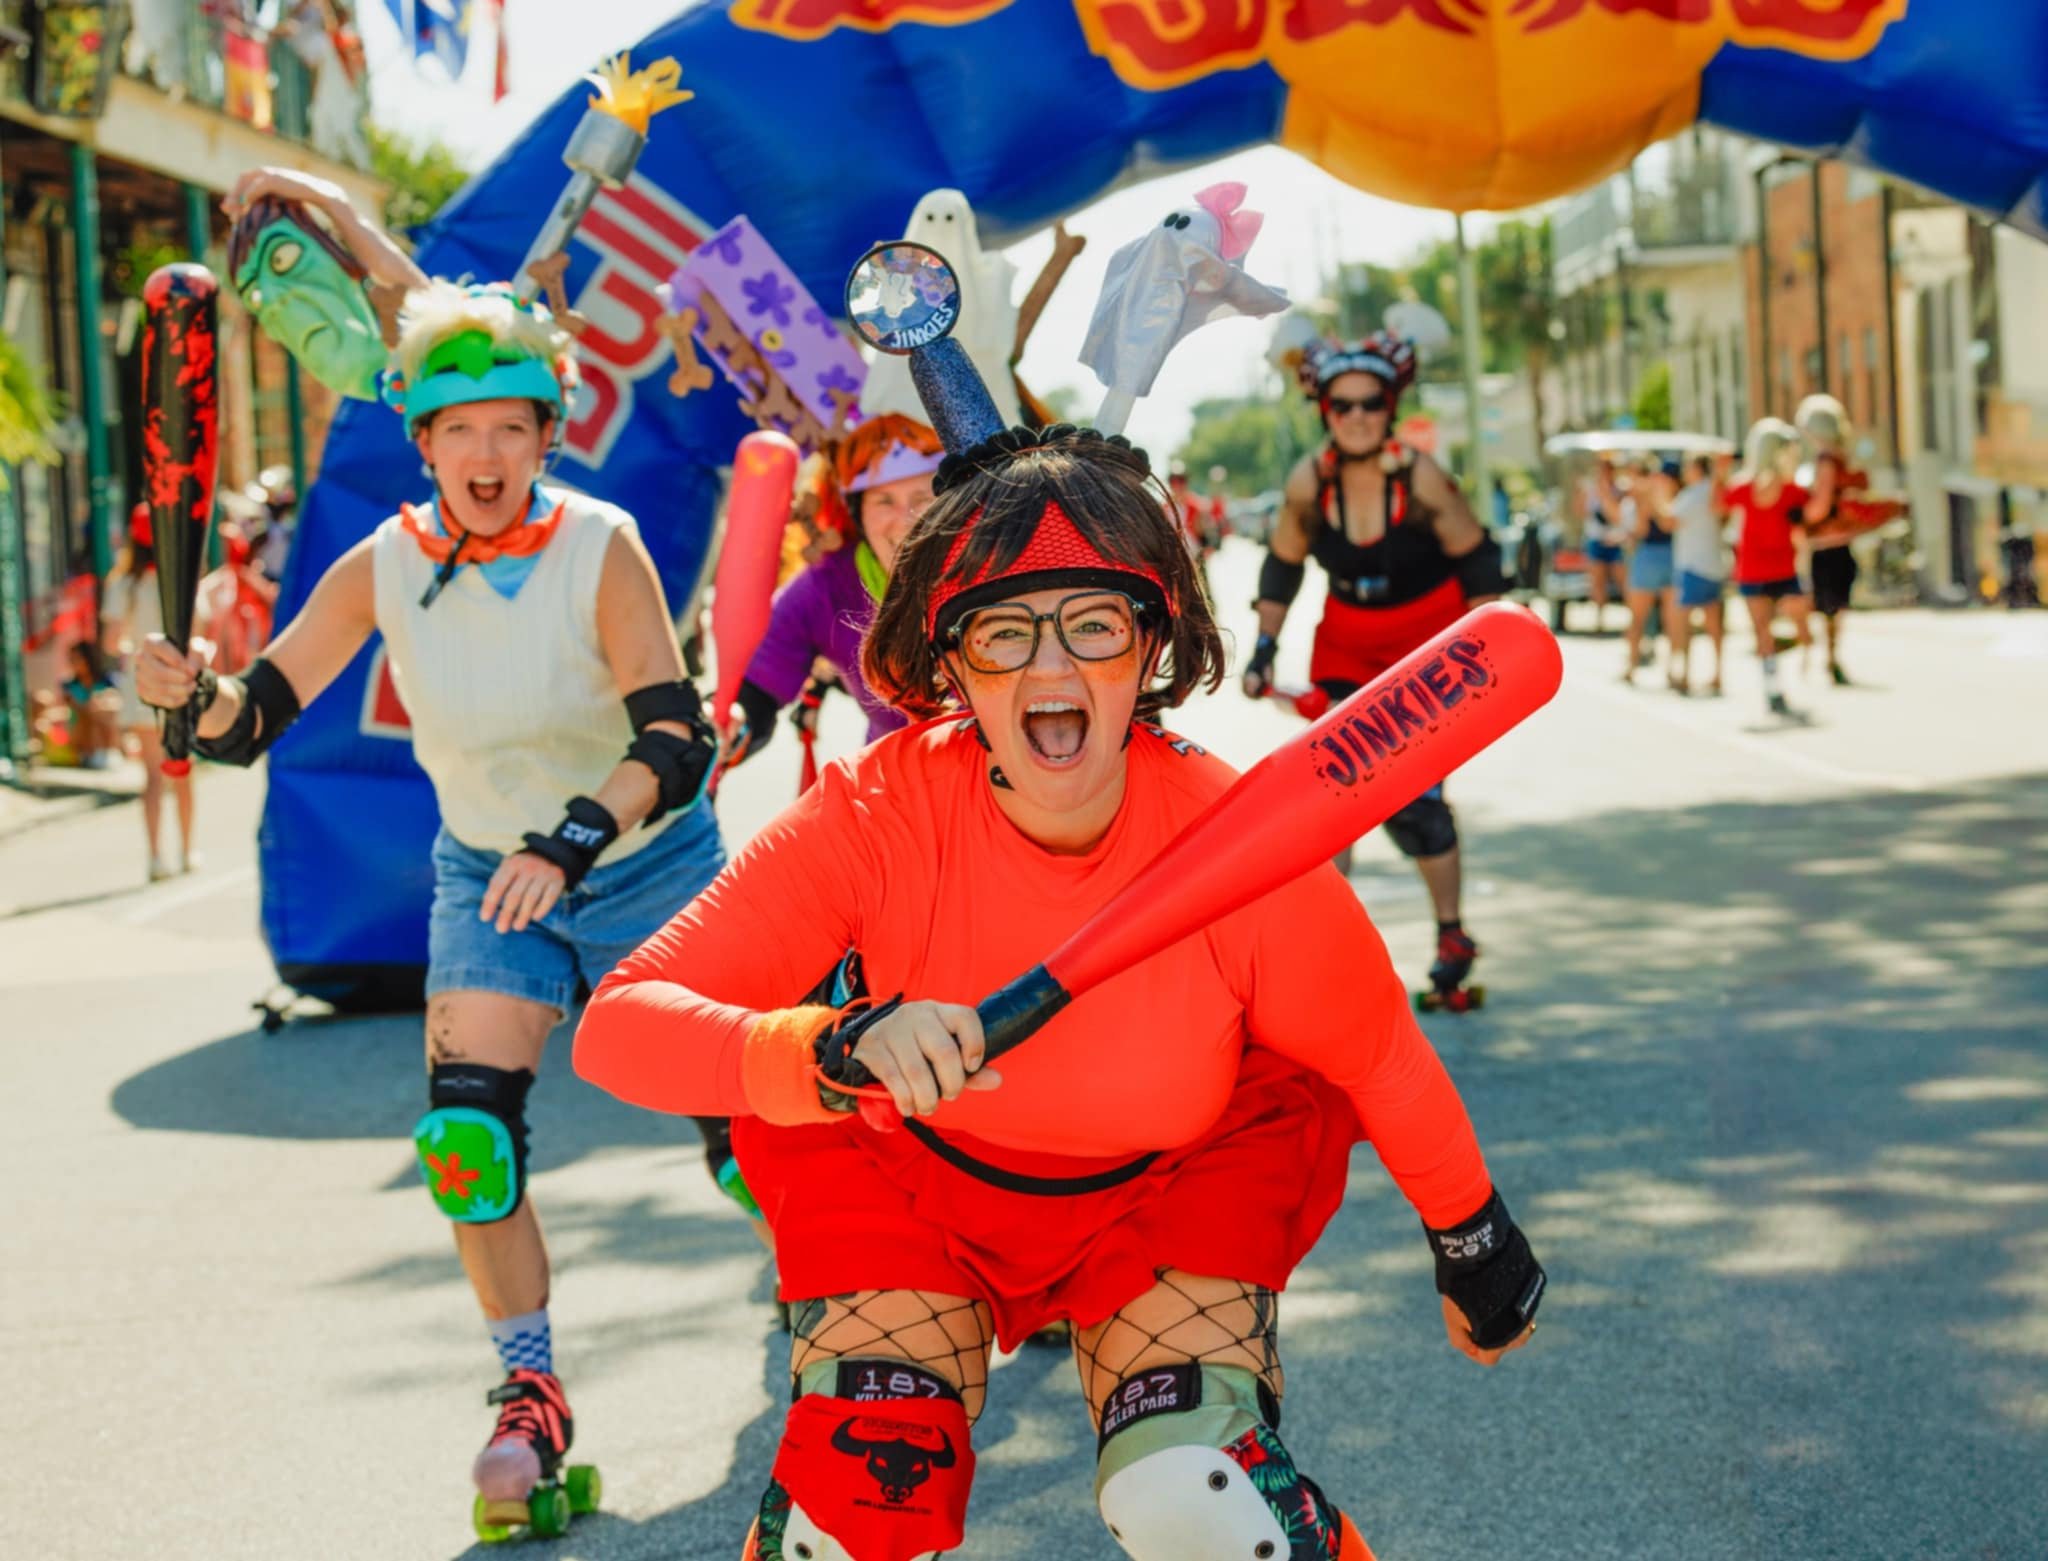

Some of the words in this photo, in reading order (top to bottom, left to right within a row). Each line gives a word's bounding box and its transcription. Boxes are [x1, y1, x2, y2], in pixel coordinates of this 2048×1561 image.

[890, 302, 954, 348] JINKIES
[1321, 639, 1489, 787] JINKIES
[862, 1369, 940, 1399] 187
[1108, 1373, 1176, 1415] 187
[1139, 1391, 1178, 1415] PADS
